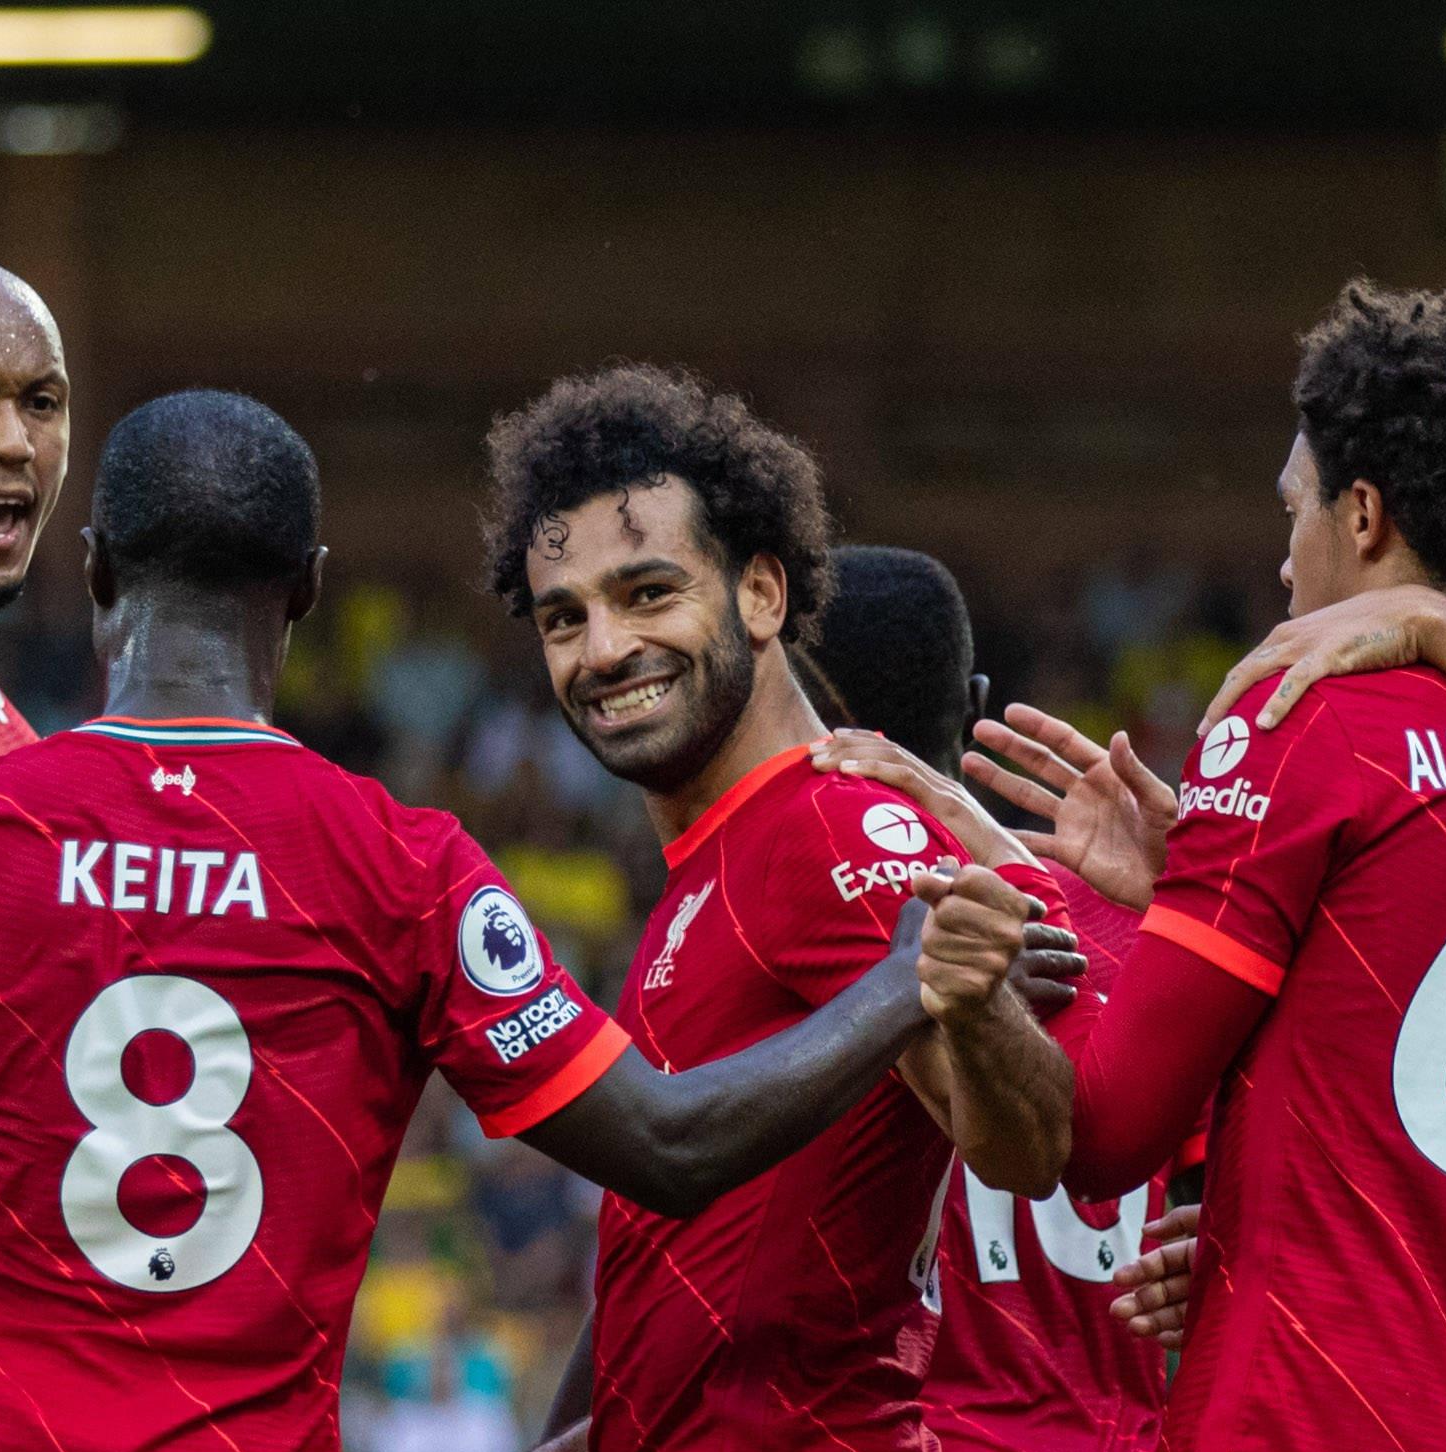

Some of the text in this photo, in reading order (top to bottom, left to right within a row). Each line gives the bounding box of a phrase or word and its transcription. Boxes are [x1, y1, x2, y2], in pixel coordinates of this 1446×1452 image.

[164, 773, 182, 785] 96
[59, 839, 269, 920] KEITA
[643, 964, 674, 990] LFC
[485, 1018, 522, 1048] No
[497, 1033, 531, 1065] for
[59, 973, 265, 1294] 8
